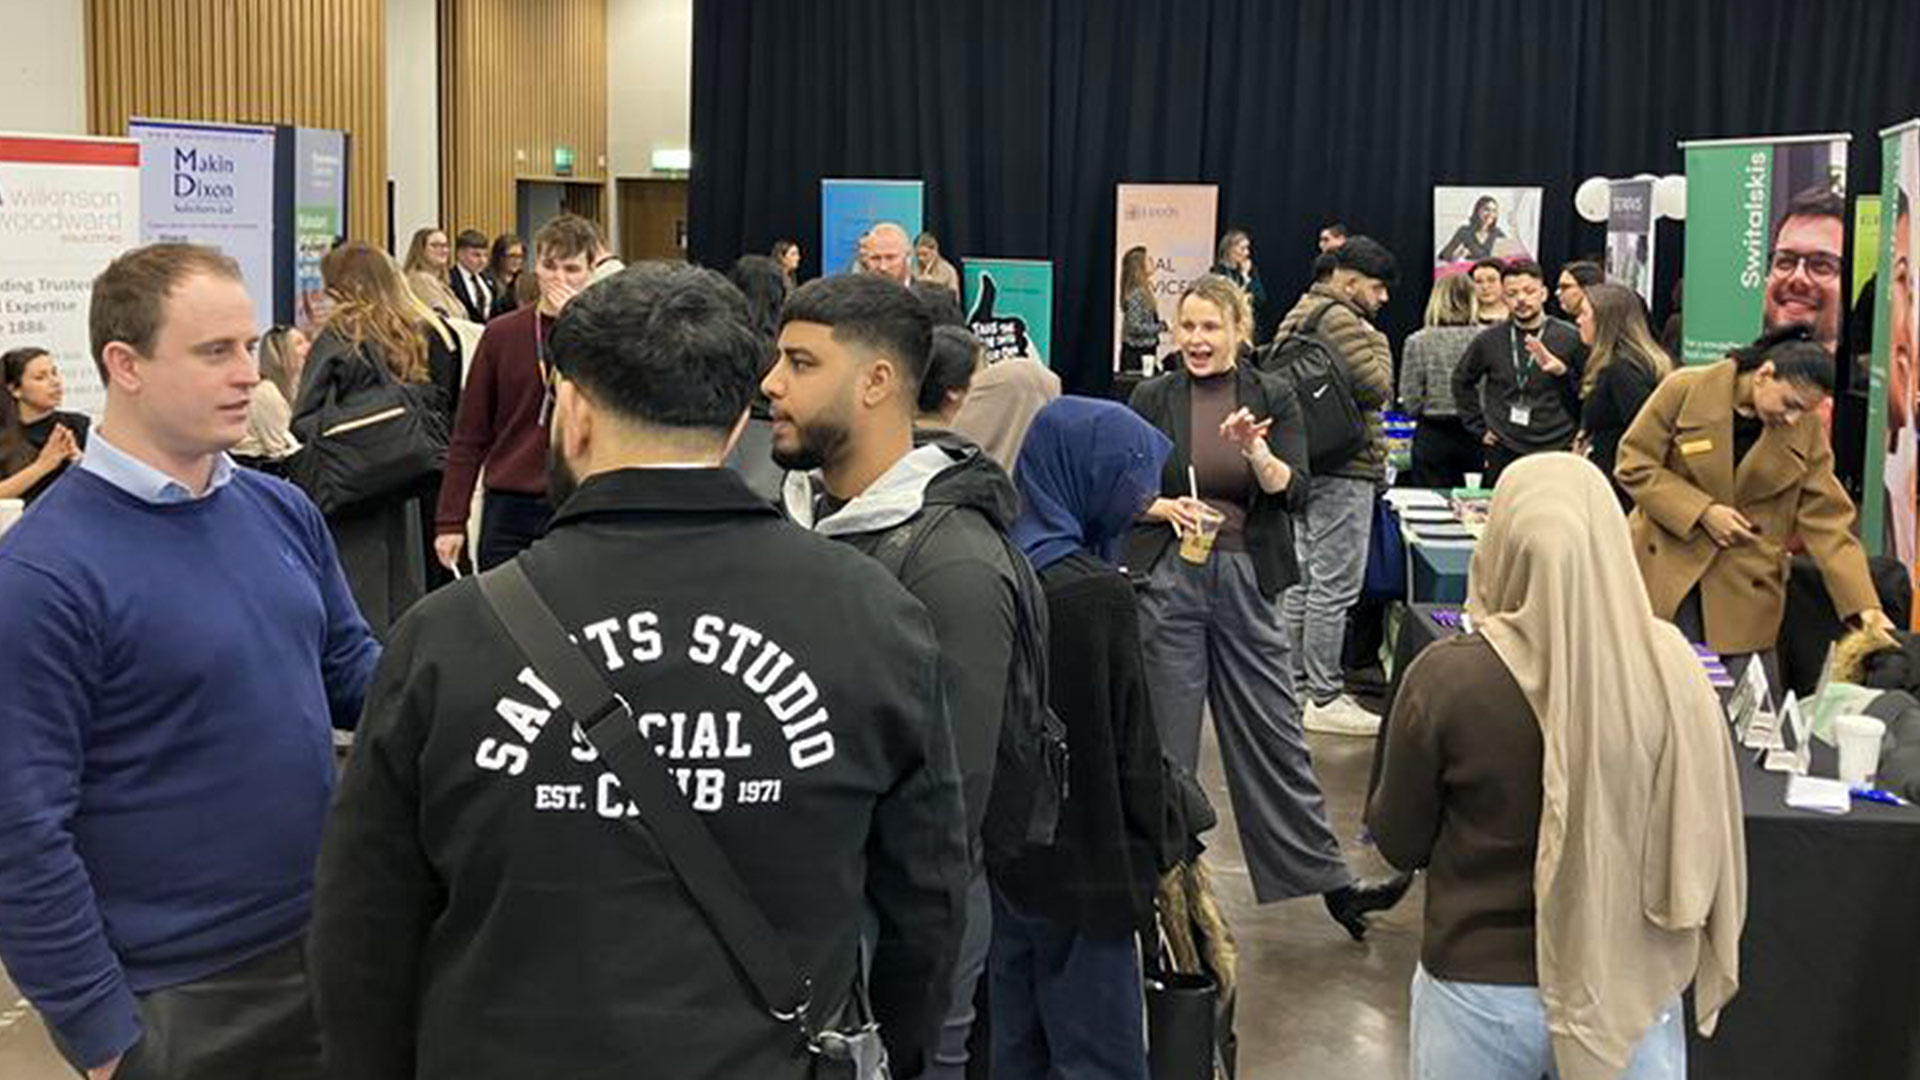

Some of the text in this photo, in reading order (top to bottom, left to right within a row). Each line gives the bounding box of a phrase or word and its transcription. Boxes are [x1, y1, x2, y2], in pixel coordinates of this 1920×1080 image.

[174, 147, 234, 172] Makin
[10, 183, 120, 208] wilkinson
[174, 173, 234, 198] Dixon
[1741, 152, 1767, 288] Switalskis
[1154, 258, 1176, 273] AL
[6, 301, 77, 314] Expertise
[475, 611, 835, 776] SAITS STUDIO
[571, 711, 752, 762] SCIAL
[535, 768, 782, 818] EST. CB 1971
